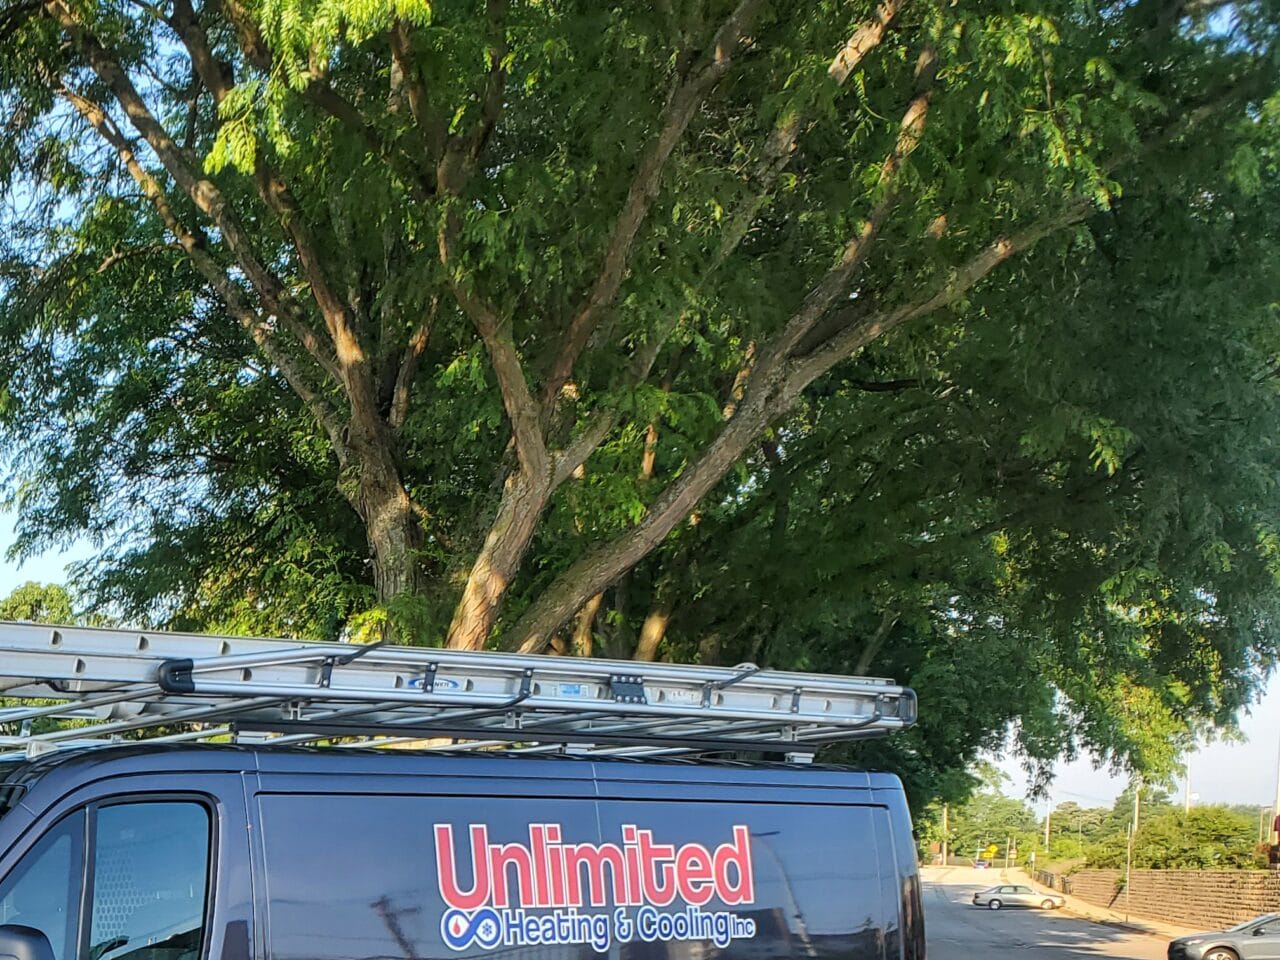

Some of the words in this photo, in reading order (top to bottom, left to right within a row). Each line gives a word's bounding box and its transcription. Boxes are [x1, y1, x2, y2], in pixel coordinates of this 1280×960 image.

[433, 823, 754, 911] Unlimited
[504, 907, 609, 952] Heating
[615, 907, 632, 942] &
[637, 905, 731, 948] Cooling
[731, 918, 756, 939] Inc
